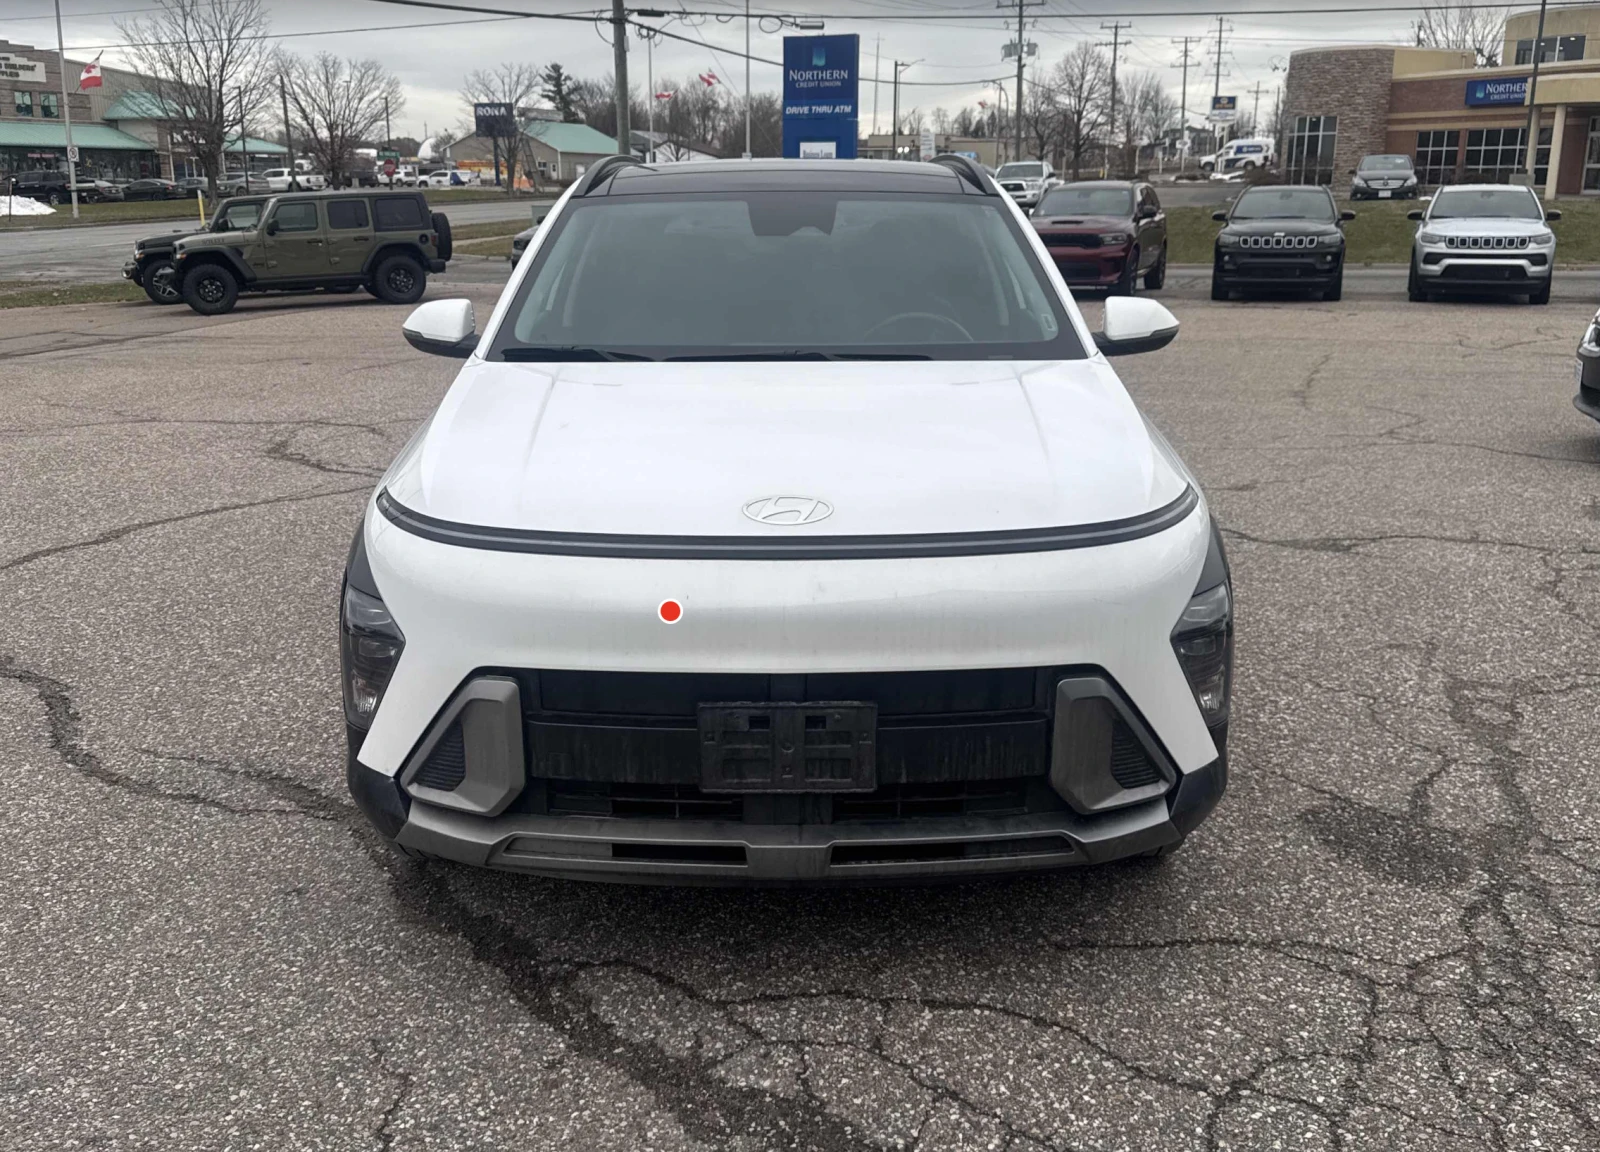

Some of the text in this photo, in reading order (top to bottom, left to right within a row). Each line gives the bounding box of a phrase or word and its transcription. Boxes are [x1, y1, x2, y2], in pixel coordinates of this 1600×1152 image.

[789, 69, 848, 81] NORTHERN
[1486, 82, 1527, 94] NORTHER
[477, 106, 507, 116] RONA
[785, 104, 852, 114] DRIVE THRU ATM
